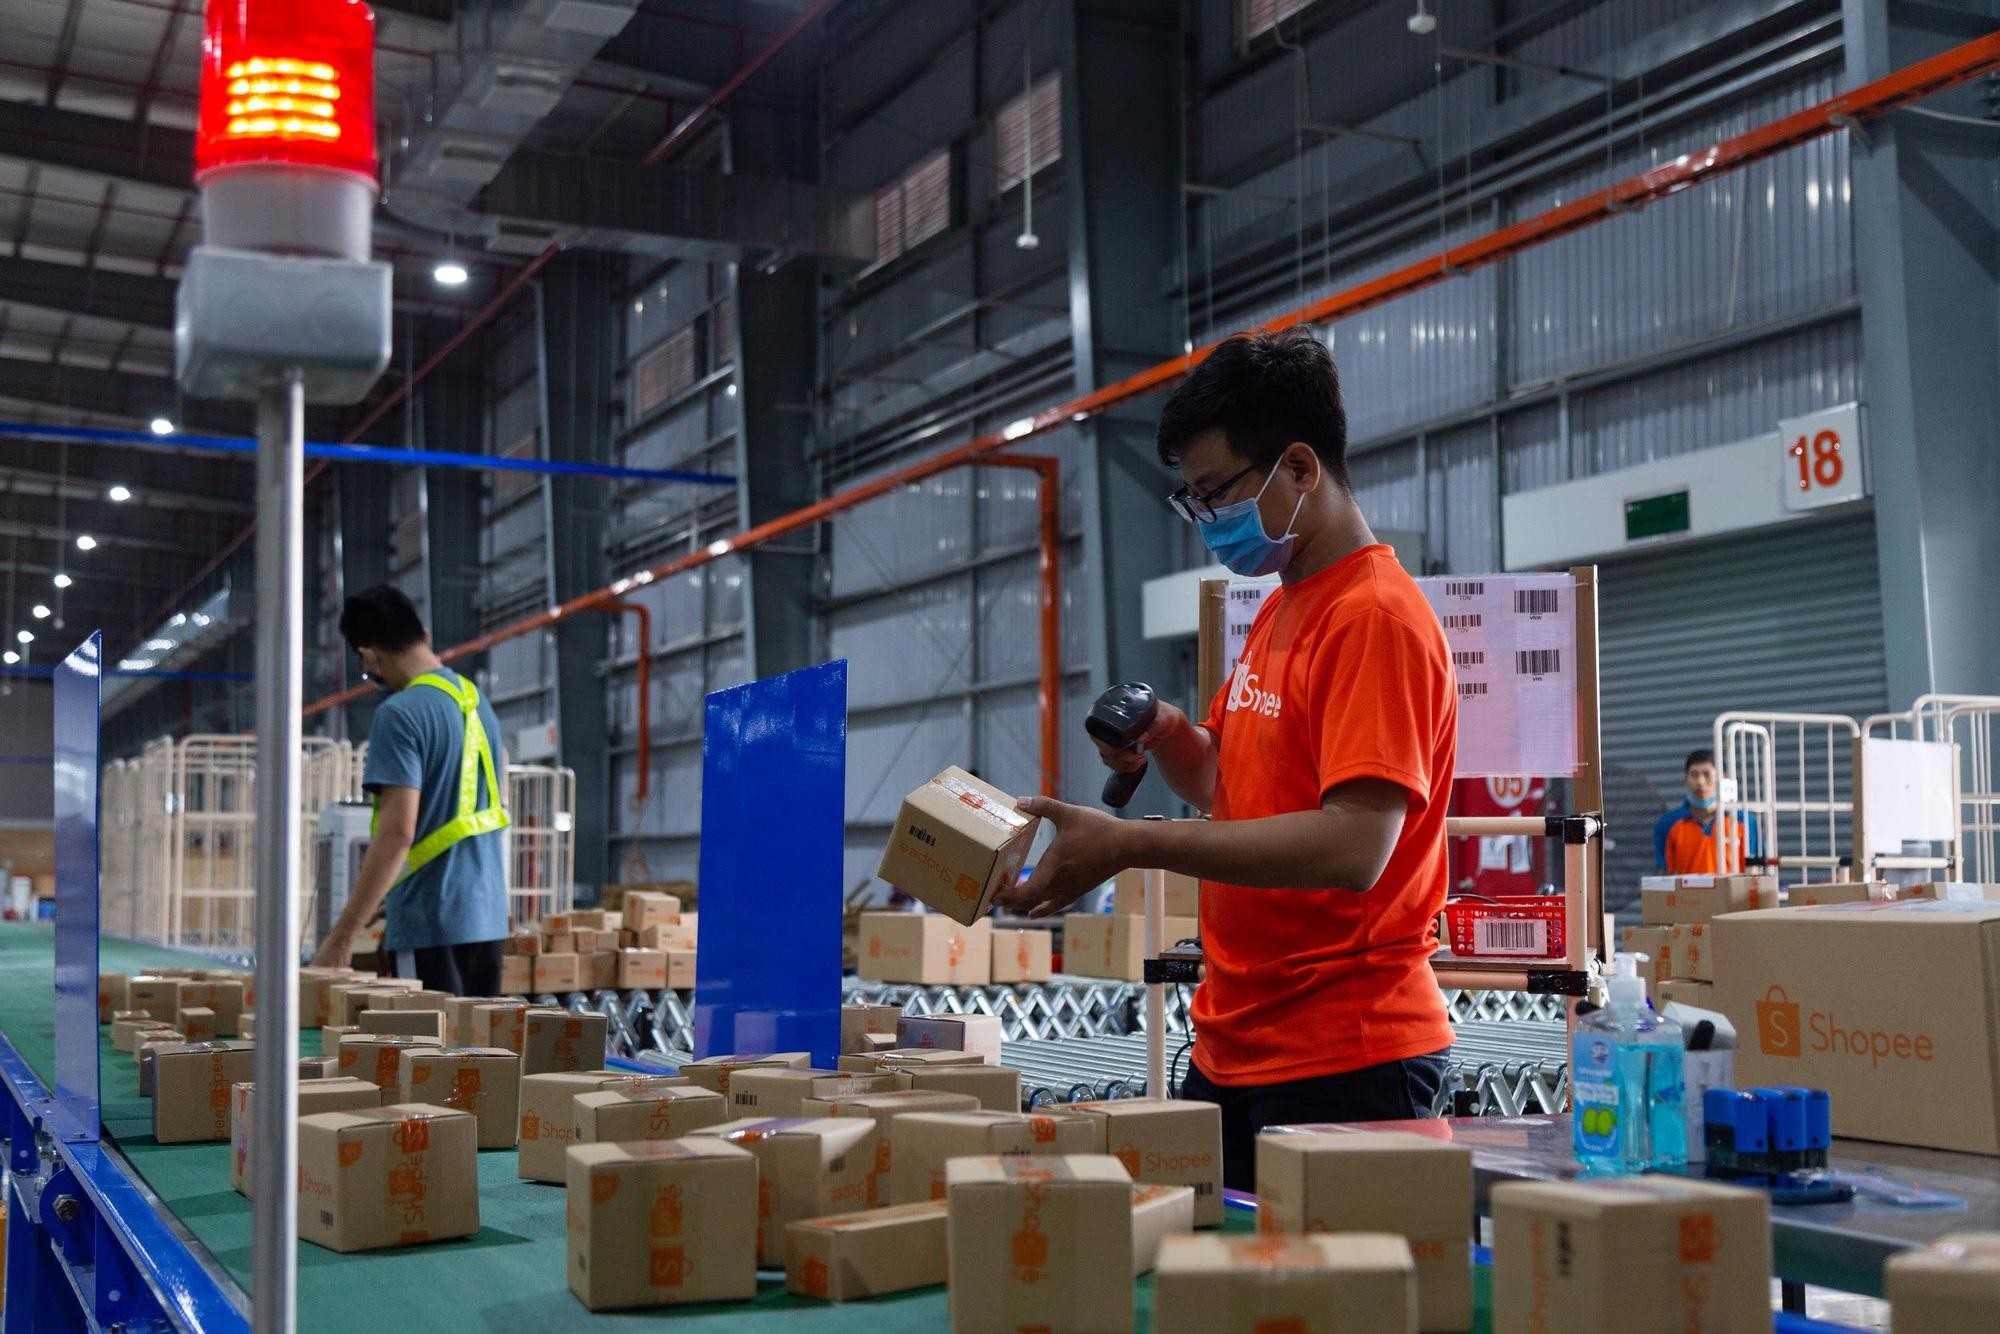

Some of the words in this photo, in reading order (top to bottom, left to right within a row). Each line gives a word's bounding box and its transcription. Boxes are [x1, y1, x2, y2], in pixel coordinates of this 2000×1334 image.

[1789, 430, 1843, 491] 18
[900, 842, 955, 883] Shopee
[1809, 1012, 1935, 1069] Shopee
[1144, 1151, 1213, 1175] Shopee
